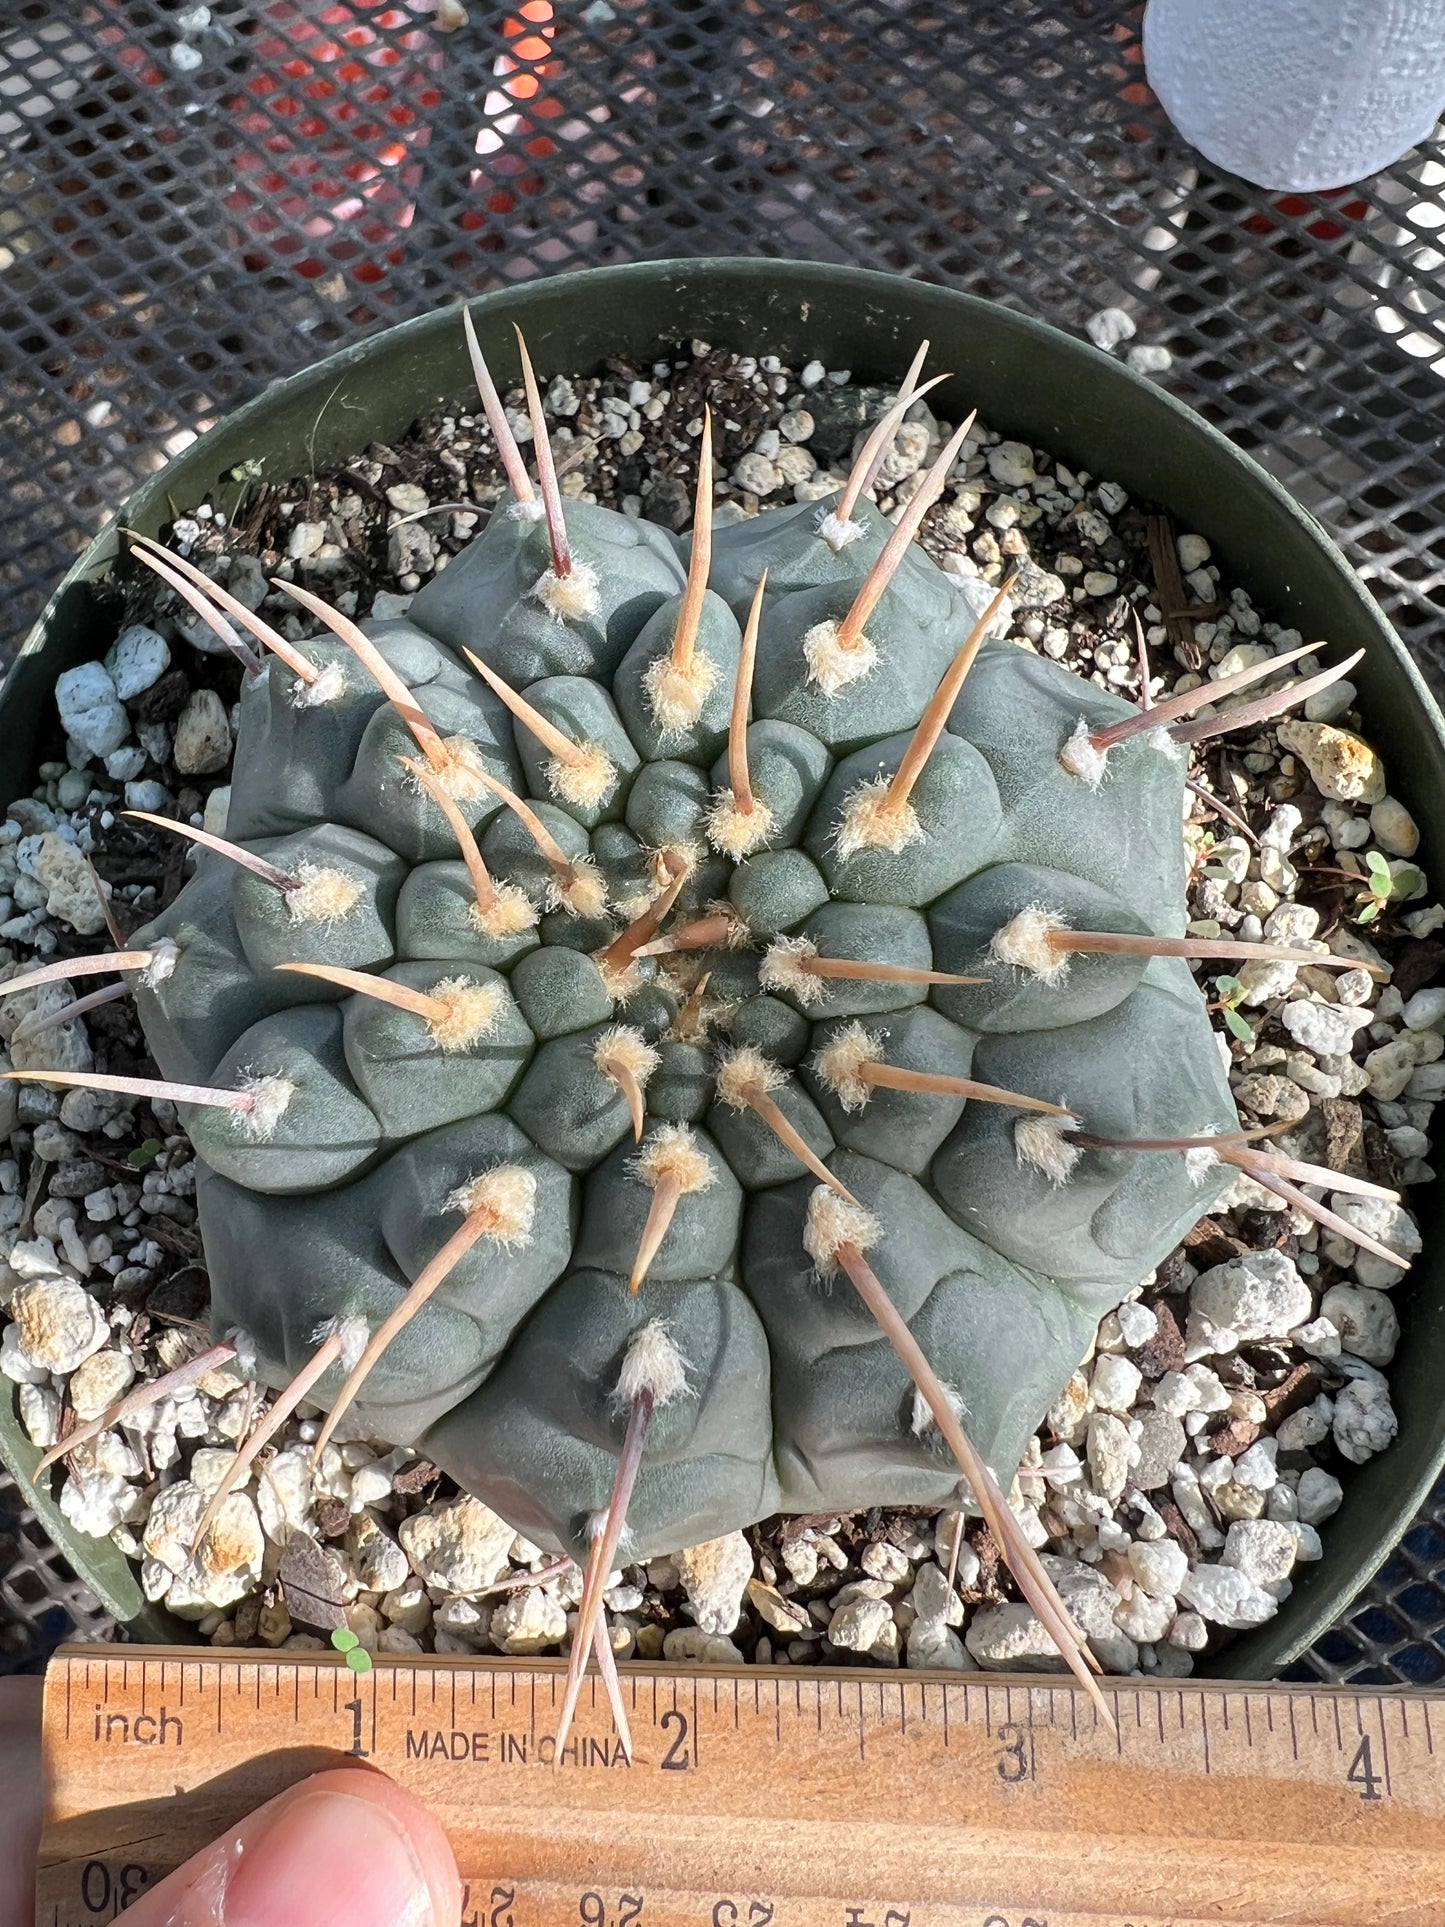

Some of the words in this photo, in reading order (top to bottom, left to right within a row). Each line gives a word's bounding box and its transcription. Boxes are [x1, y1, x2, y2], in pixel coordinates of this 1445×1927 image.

[94, 1704, 183, 1746] inch
[345, 1698, 370, 1757] 1
[406, 1729, 489, 1762] MADE
[501, 1732, 527, 1763] IN
[538, 1736, 632, 1767] CHINA
[660, 1711, 690, 1770] 2
[997, 1722, 1027, 1782] 3
[1347, 1734, 1382, 1800] 4
[81, 1860, 148, 1913] 30
